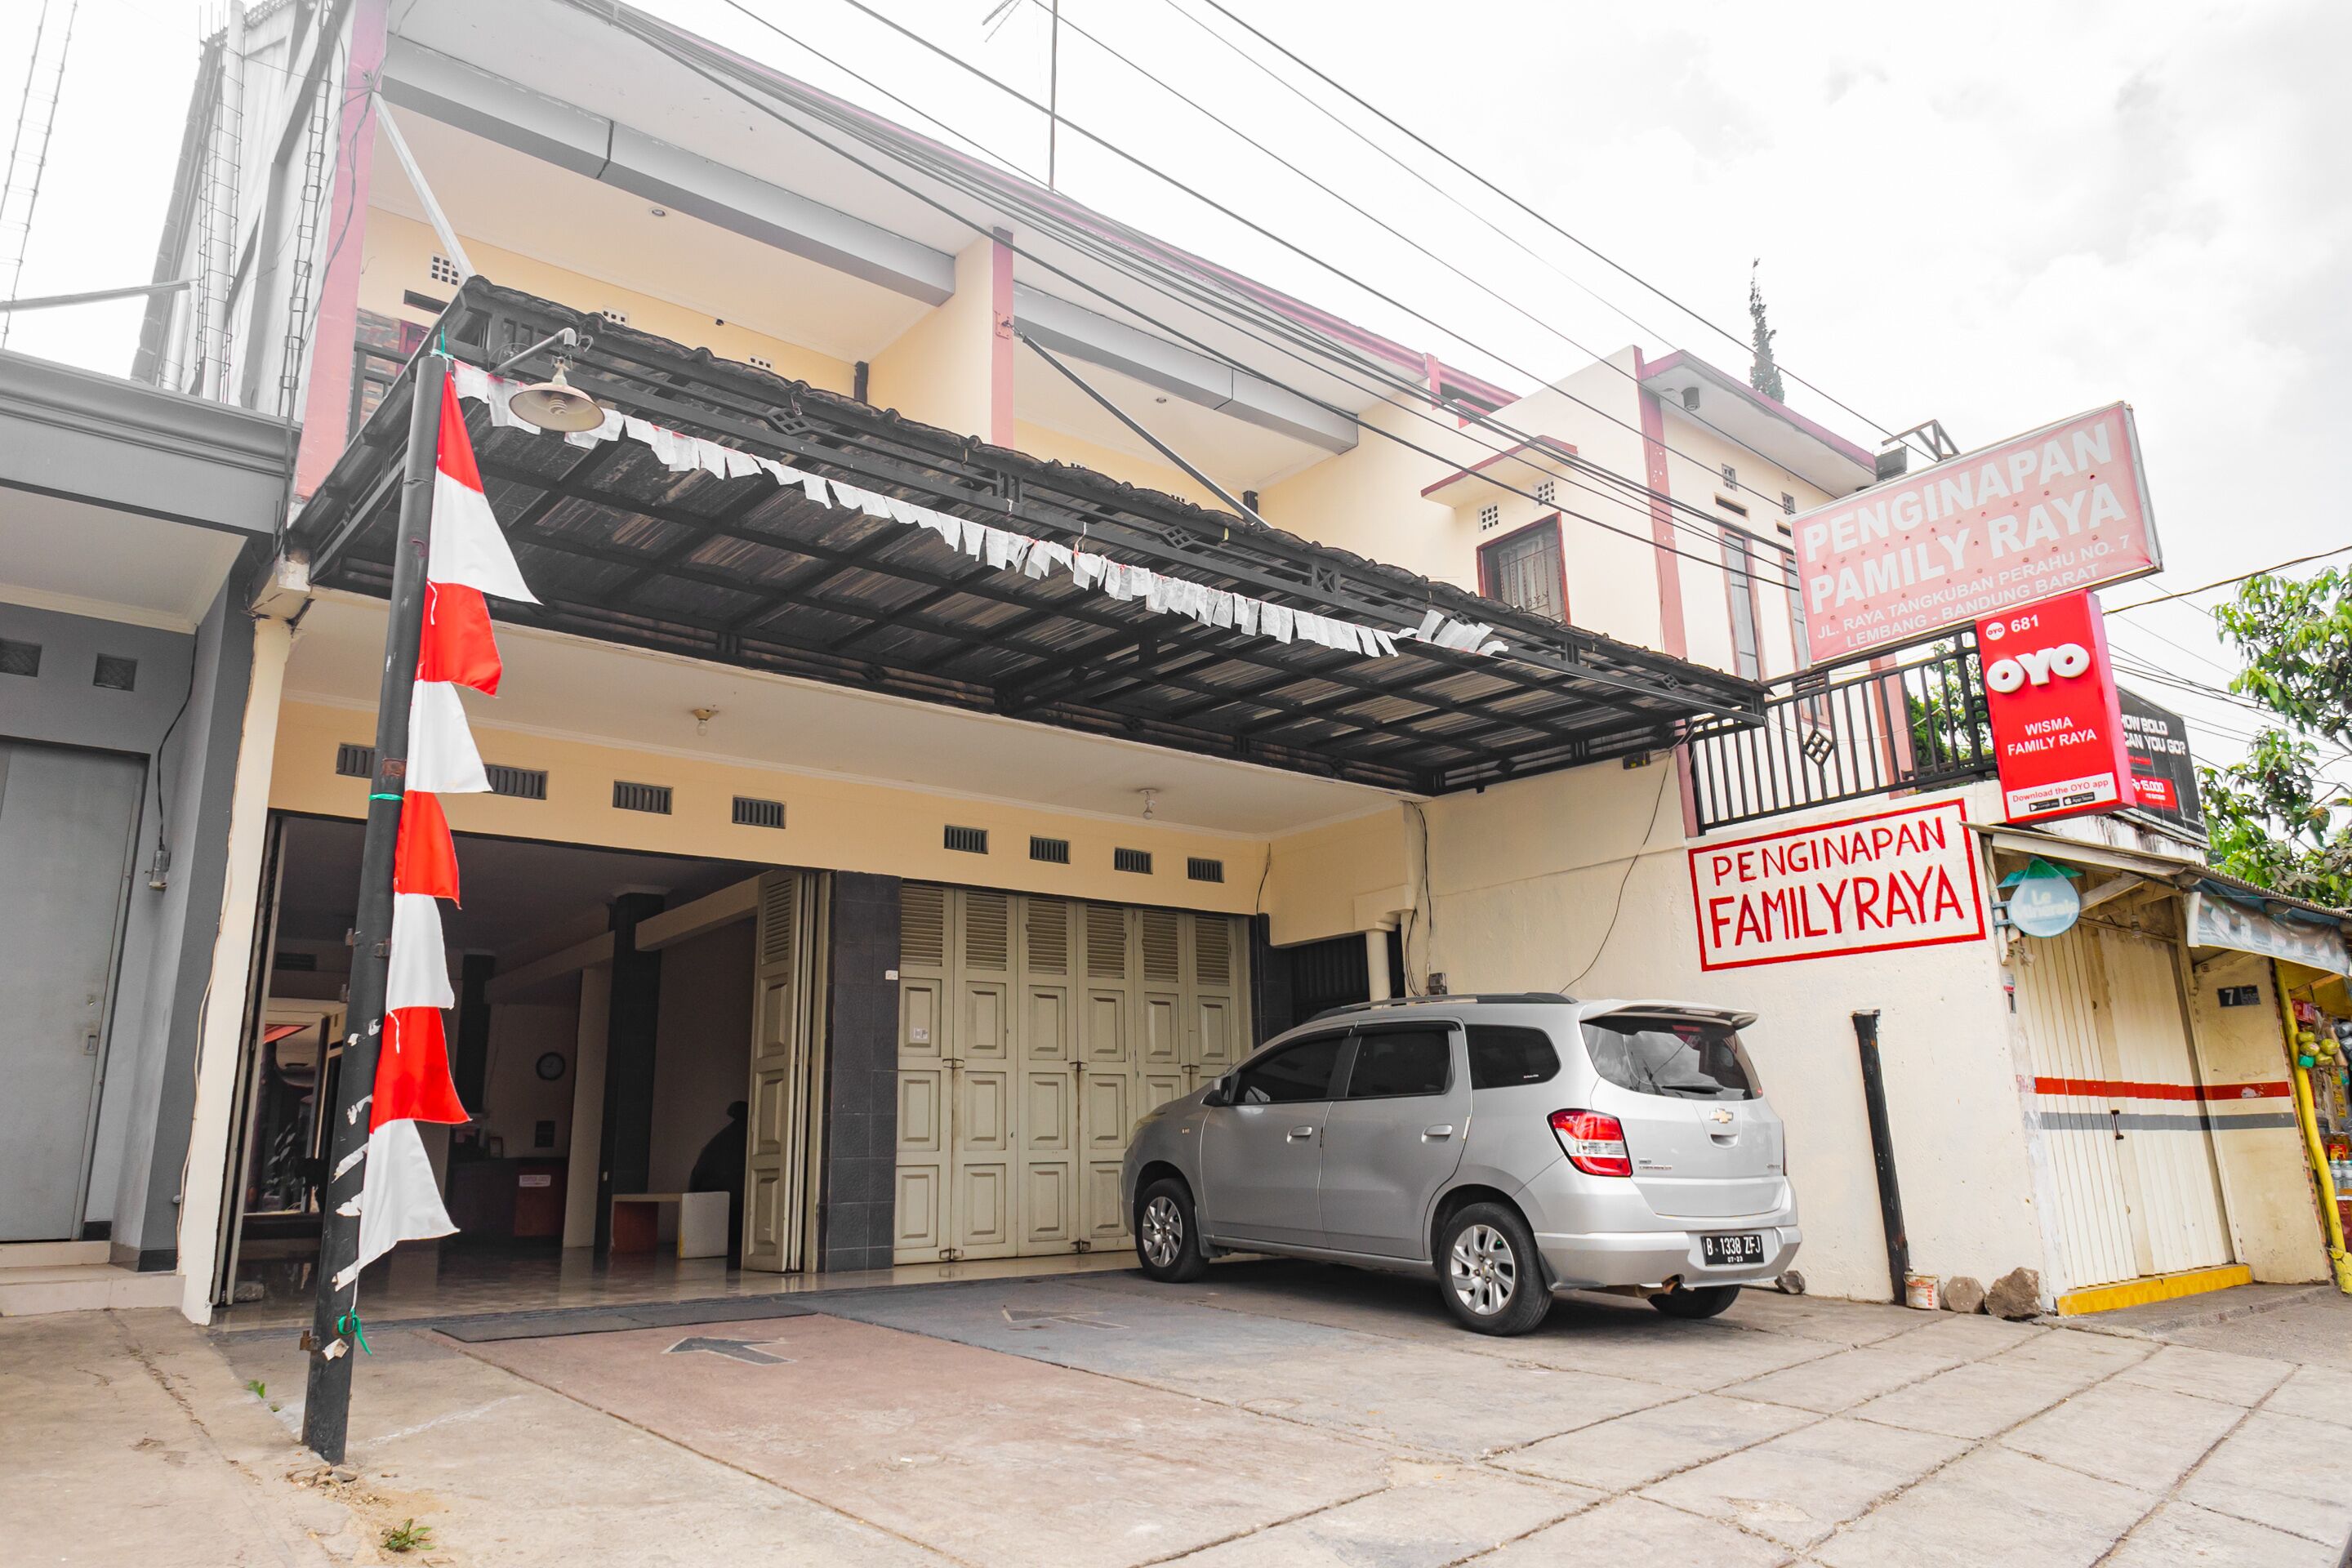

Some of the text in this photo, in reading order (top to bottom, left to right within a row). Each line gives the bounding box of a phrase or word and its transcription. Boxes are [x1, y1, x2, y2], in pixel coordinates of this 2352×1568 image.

[1802, 422, 2113, 563] PENGINAPAN
[1987, 483, 2127, 559] RAYA
[1817, 535, 2130, 639] JL. RAYA TANGKUBAN PERAHU NO. 7
[1846, 614, 1927, 648] LEMBANG
[1941, 584, 2030, 620] BANDUNG
[2035, 564, 2099, 593] BARAT
[2011, 614, 2038, 632] 681
[1987, 643, 2090, 694] OYO
[2025, 716, 2074, 737] WISMA
[2140, 717, 2168, 736] BOLD
[2007, 728, 2097, 756] FAMILY RAYA
[2145, 736, 2167, 753] YOU
[2167, 739, 2186, 755] GO?
[2012, 779, 2109, 803] Download the OYO app
[1713, 817, 1946, 886] PENGINAPAN
[2225, 989, 2234, 1004] 7
[1706, 1236, 1761, 1256] B 1338 ZFJ
